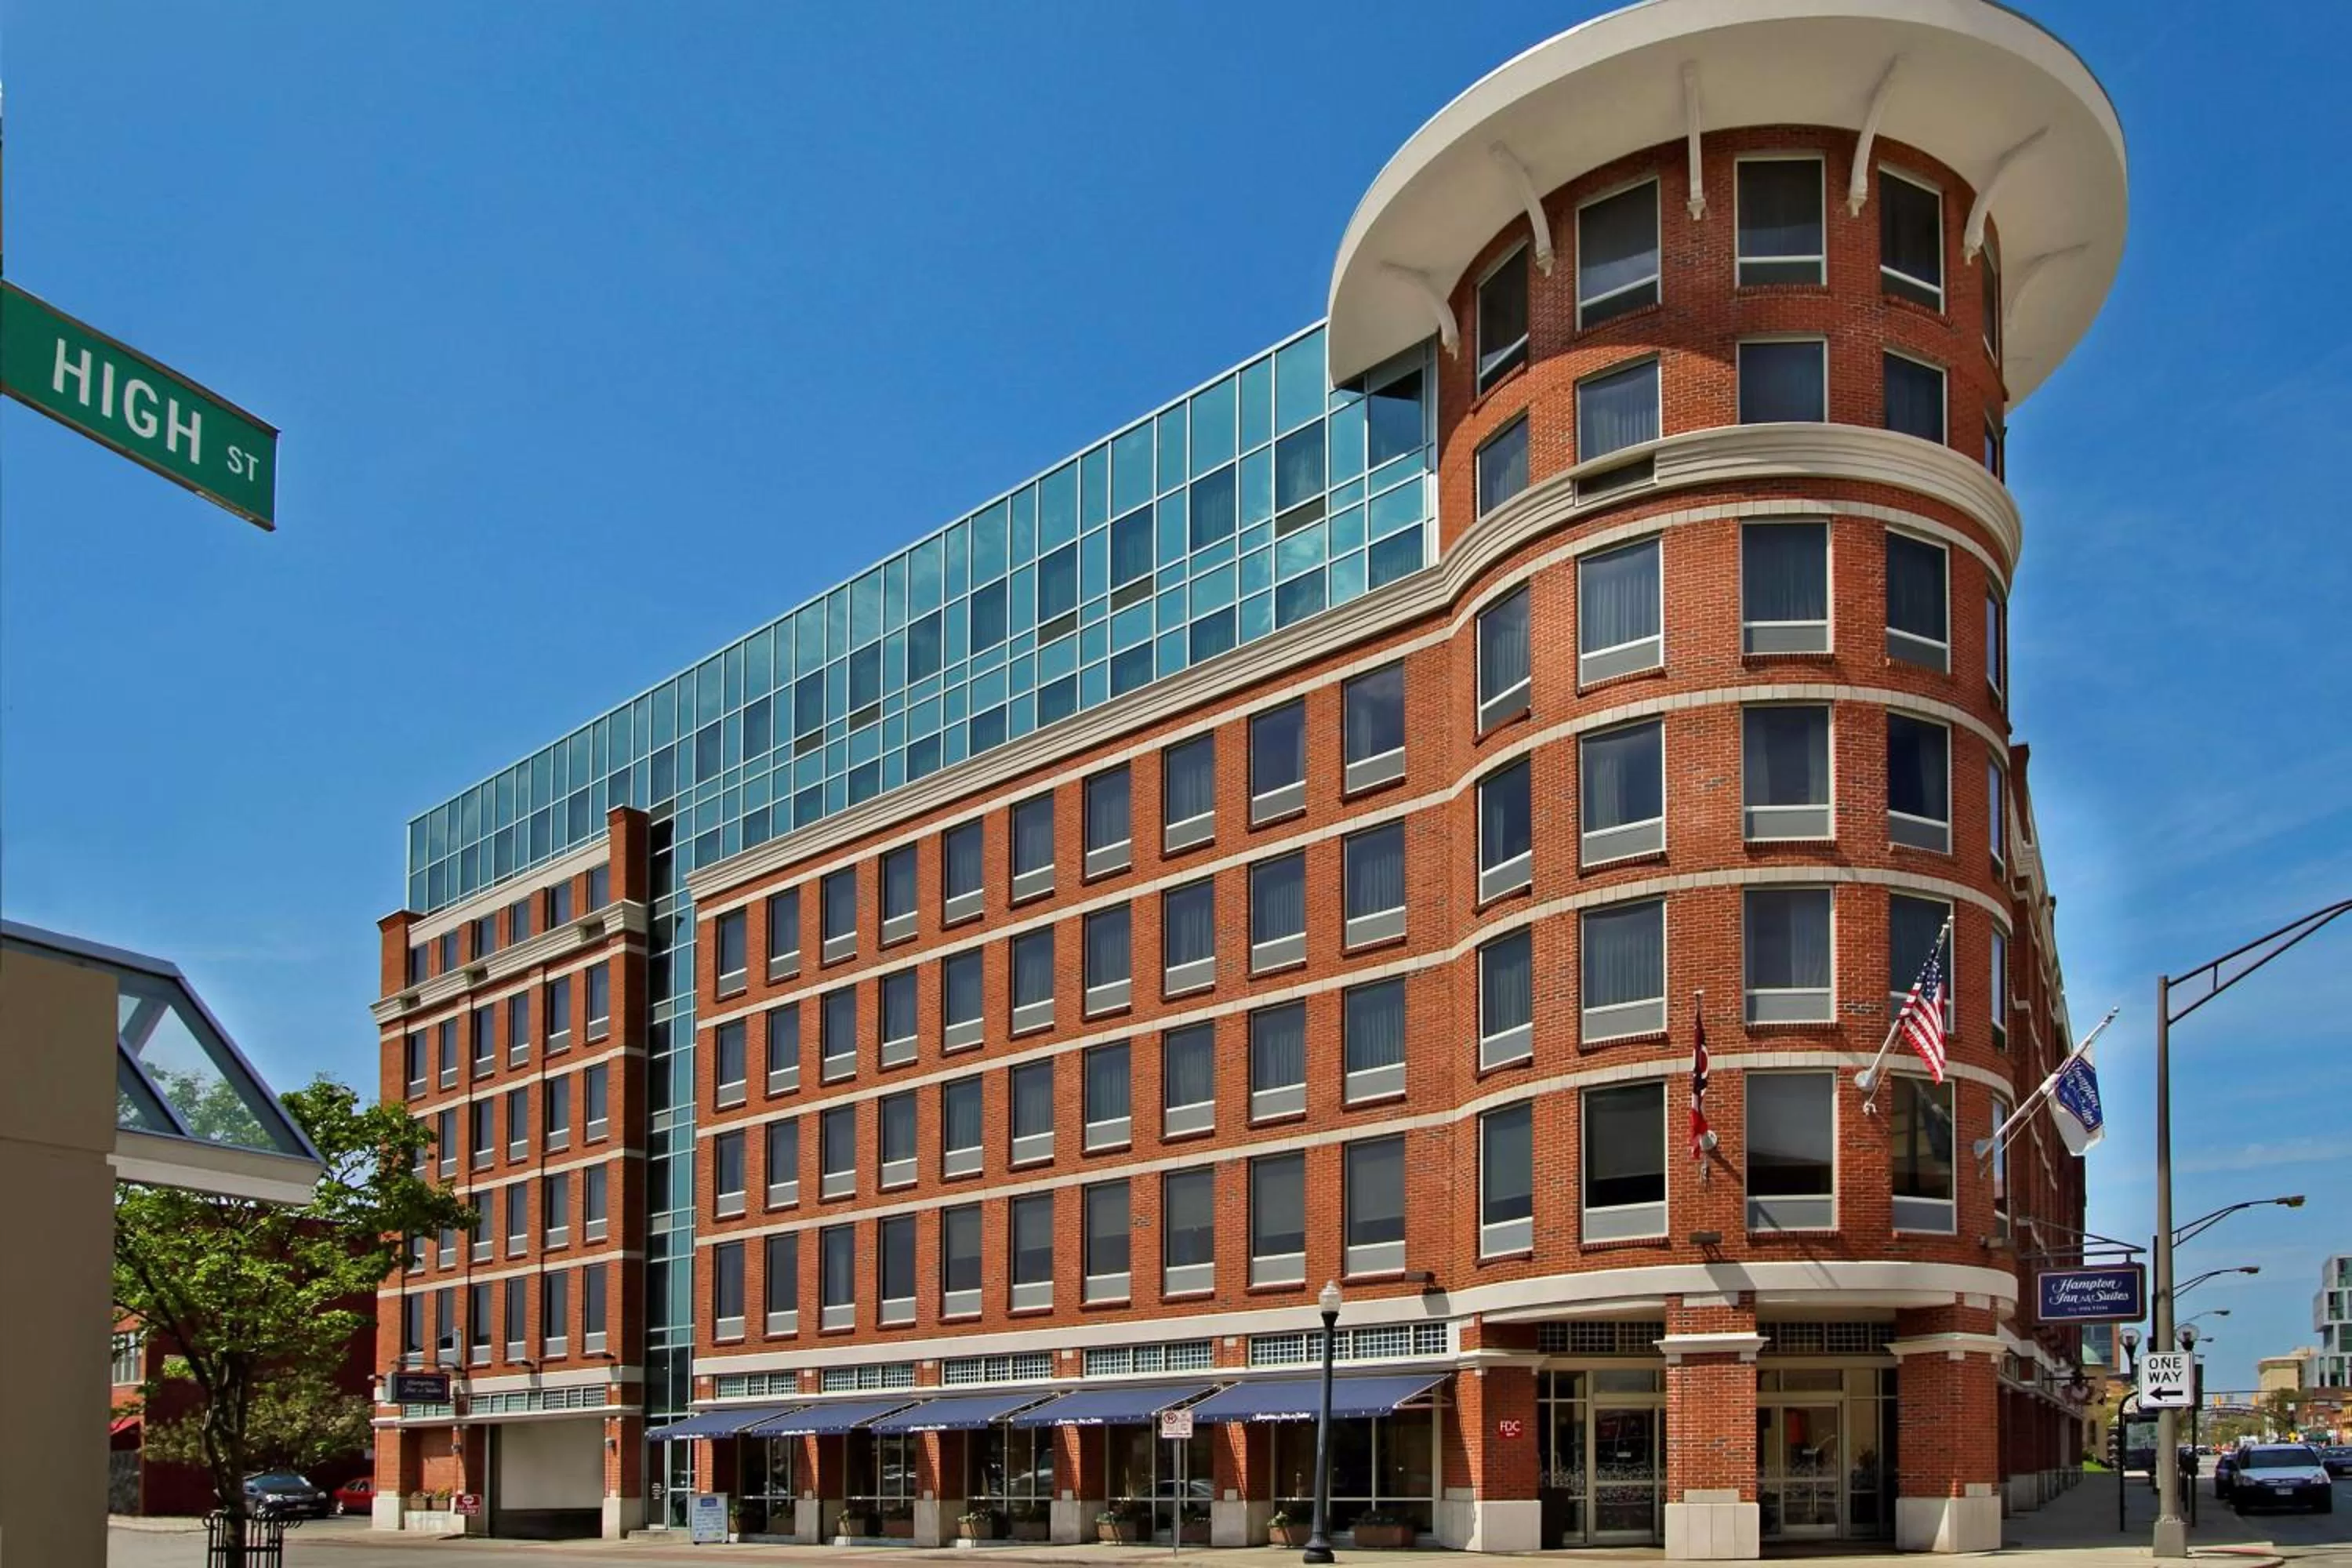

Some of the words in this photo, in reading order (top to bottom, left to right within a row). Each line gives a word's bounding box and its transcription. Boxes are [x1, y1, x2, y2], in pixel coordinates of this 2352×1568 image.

[53, 337, 201, 465] HIGH
[227, 445, 260, 482] ST
[2052, 1277, 2123, 1294] Hampton
[2049, 1292, 2078, 1305] Inn
[2092, 1290, 2129, 1302] Suites
[2149, 1357, 2182, 1370] ONE
[2149, 1371, 2183, 1384] WAY
[1500, 1420, 1521, 1432] FDC
